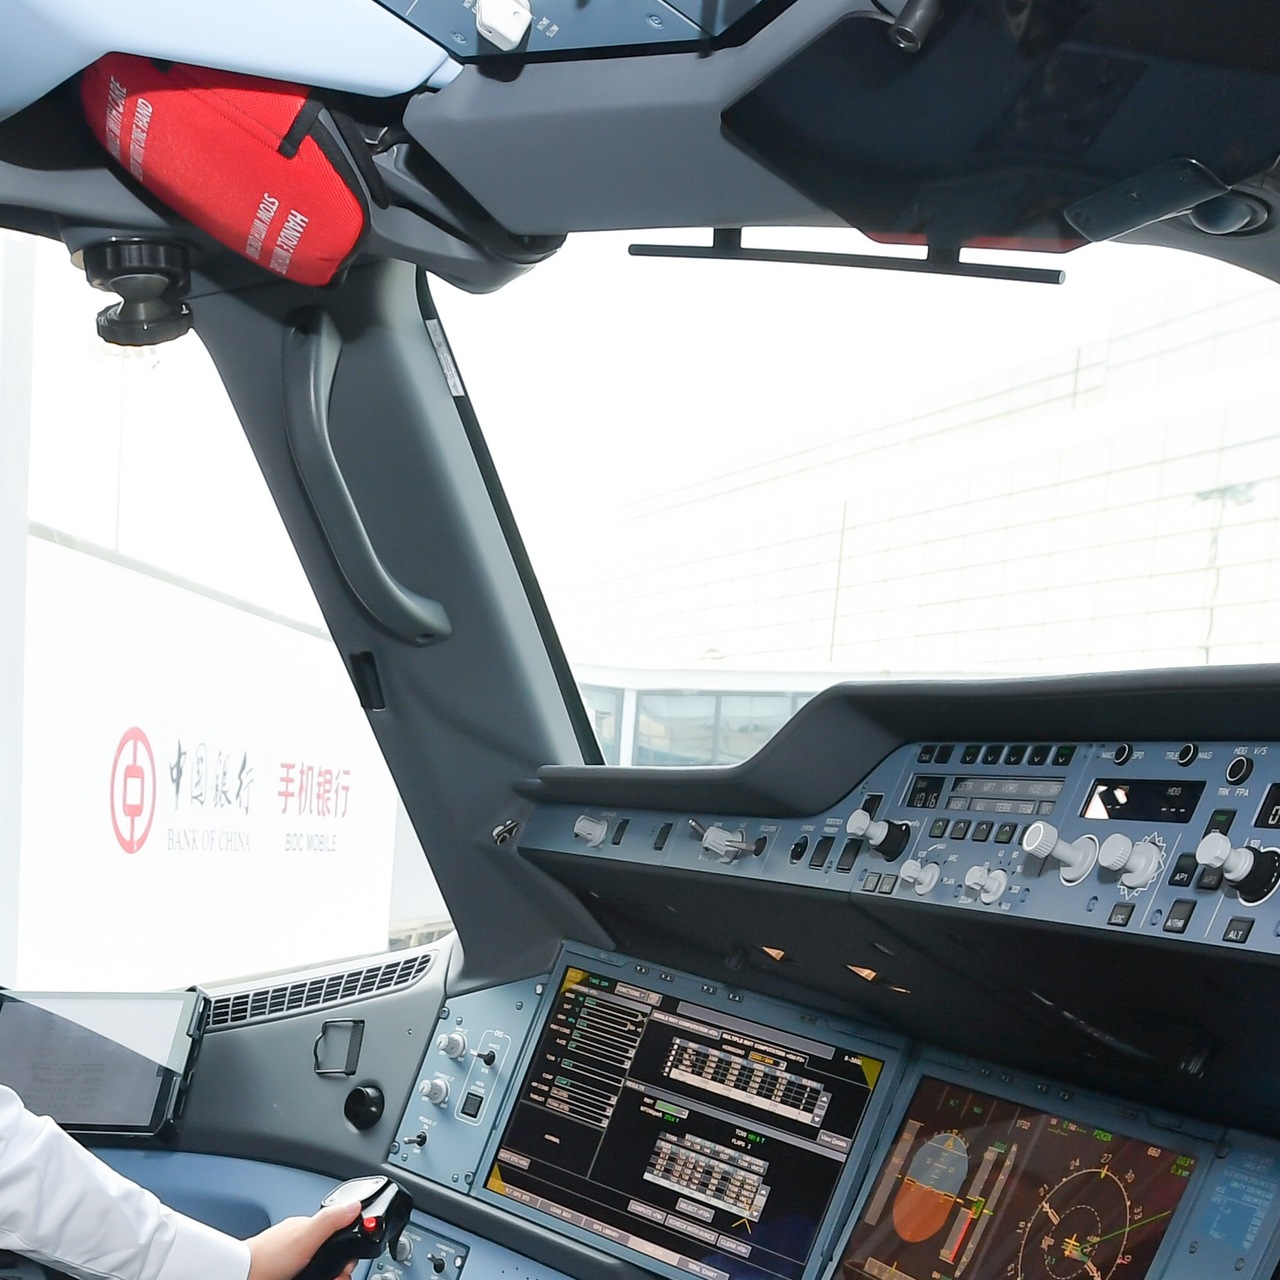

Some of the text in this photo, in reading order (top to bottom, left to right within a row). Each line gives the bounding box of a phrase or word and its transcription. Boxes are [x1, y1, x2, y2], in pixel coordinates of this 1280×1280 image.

[278, 762, 350, 818] 手机银行
[168, 829, 250, 851] BANK OF CHINA
[285, 834, 336, 852] BOC MOBILE
[1227, 930, 1244, 939] ALT
